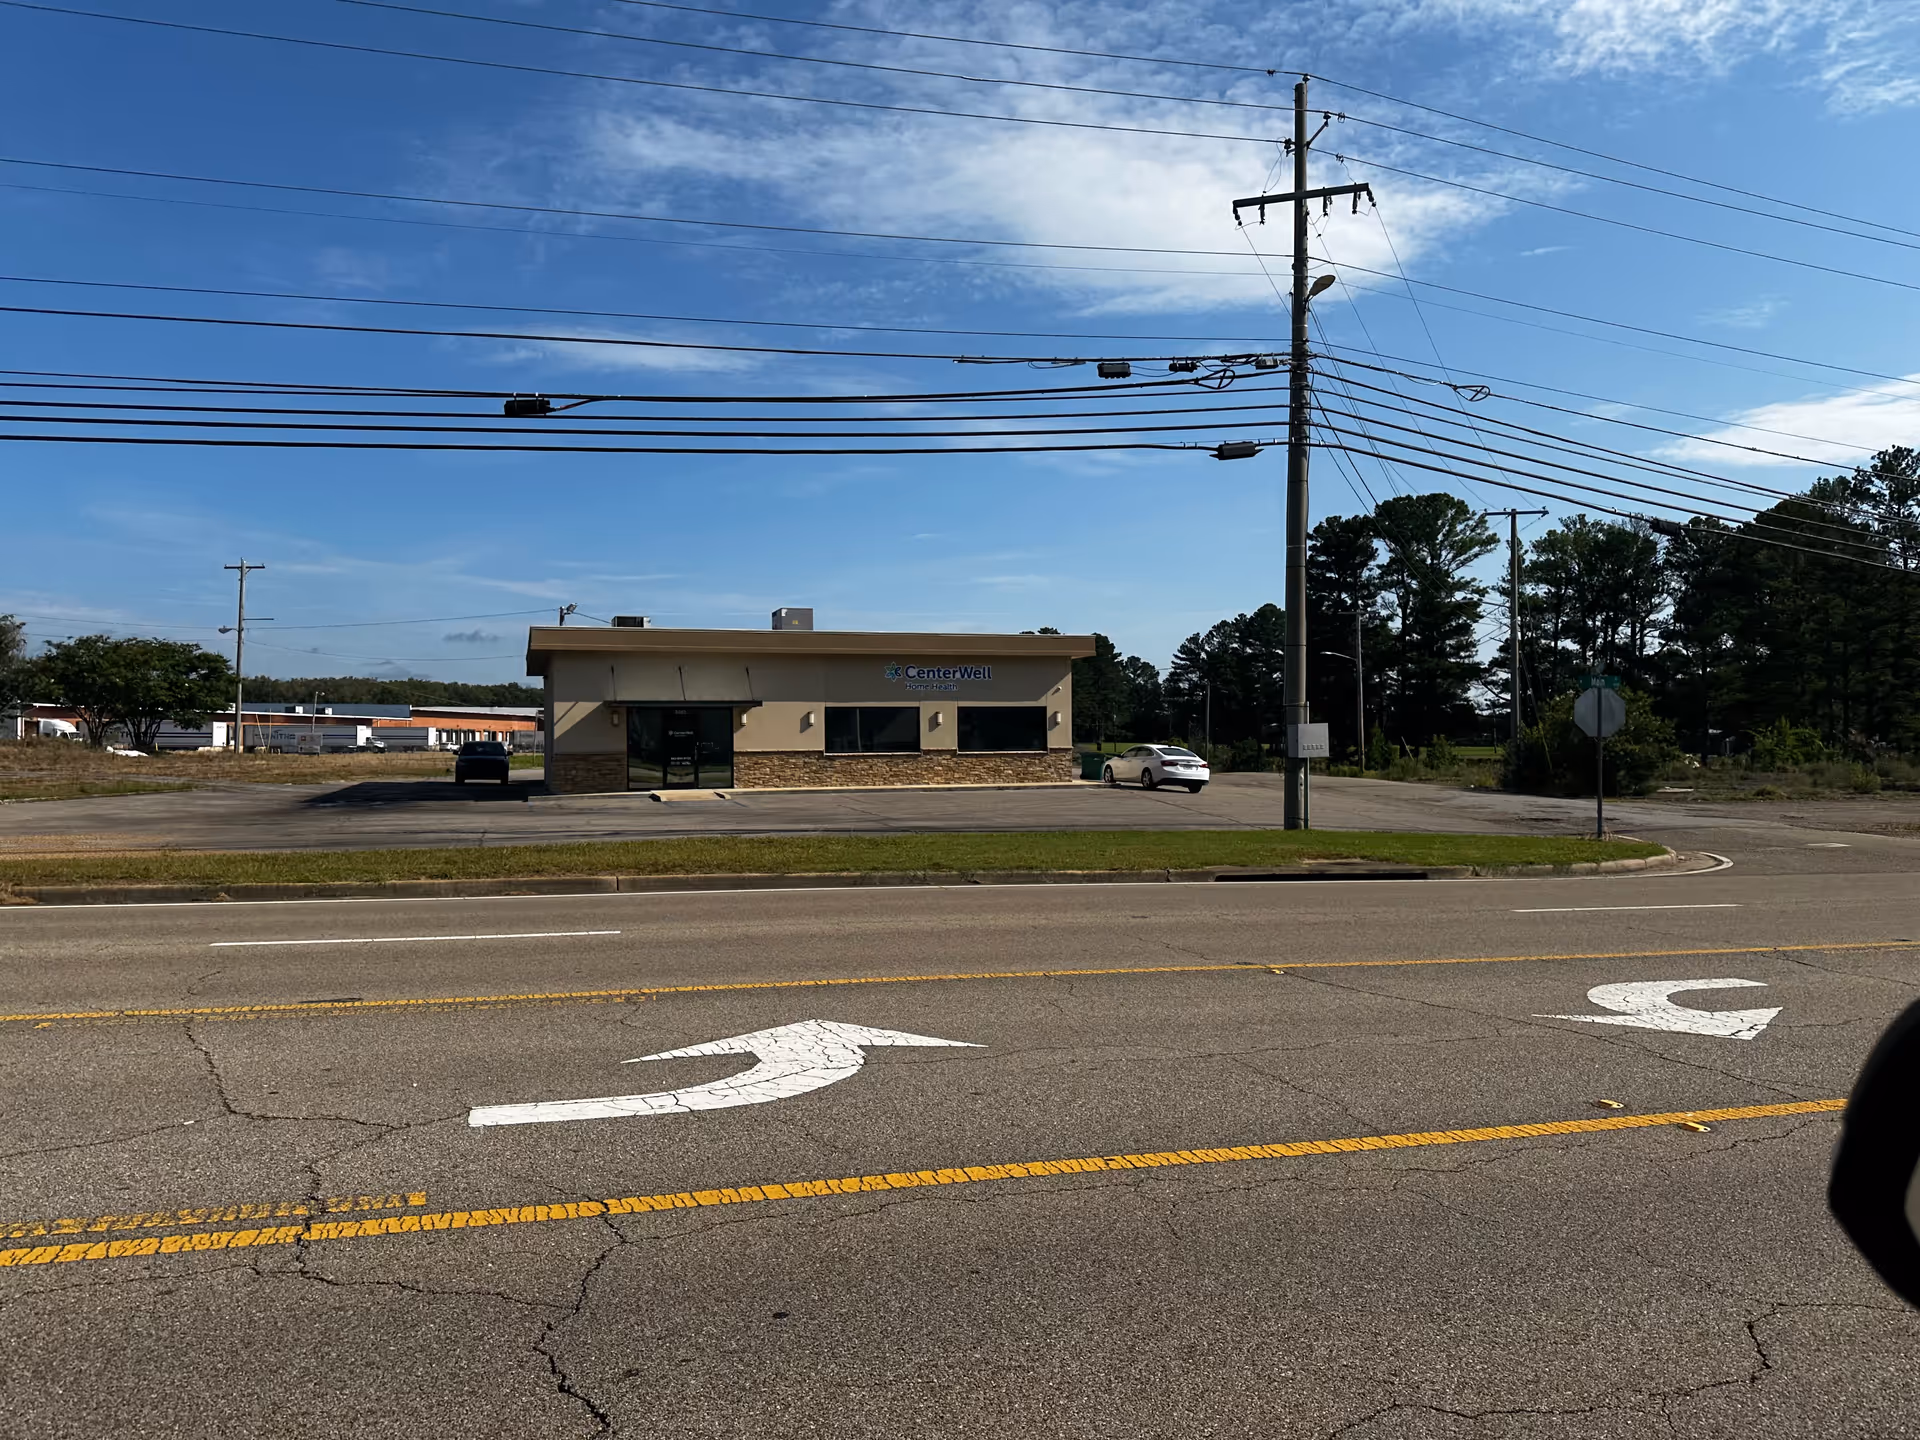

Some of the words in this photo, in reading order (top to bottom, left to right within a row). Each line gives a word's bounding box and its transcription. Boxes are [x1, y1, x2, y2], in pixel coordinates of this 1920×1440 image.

[904, 665, 992, 680] CenterWell
[905, 683, 930, 691] Home
[931, 683, 958, 691] Health
